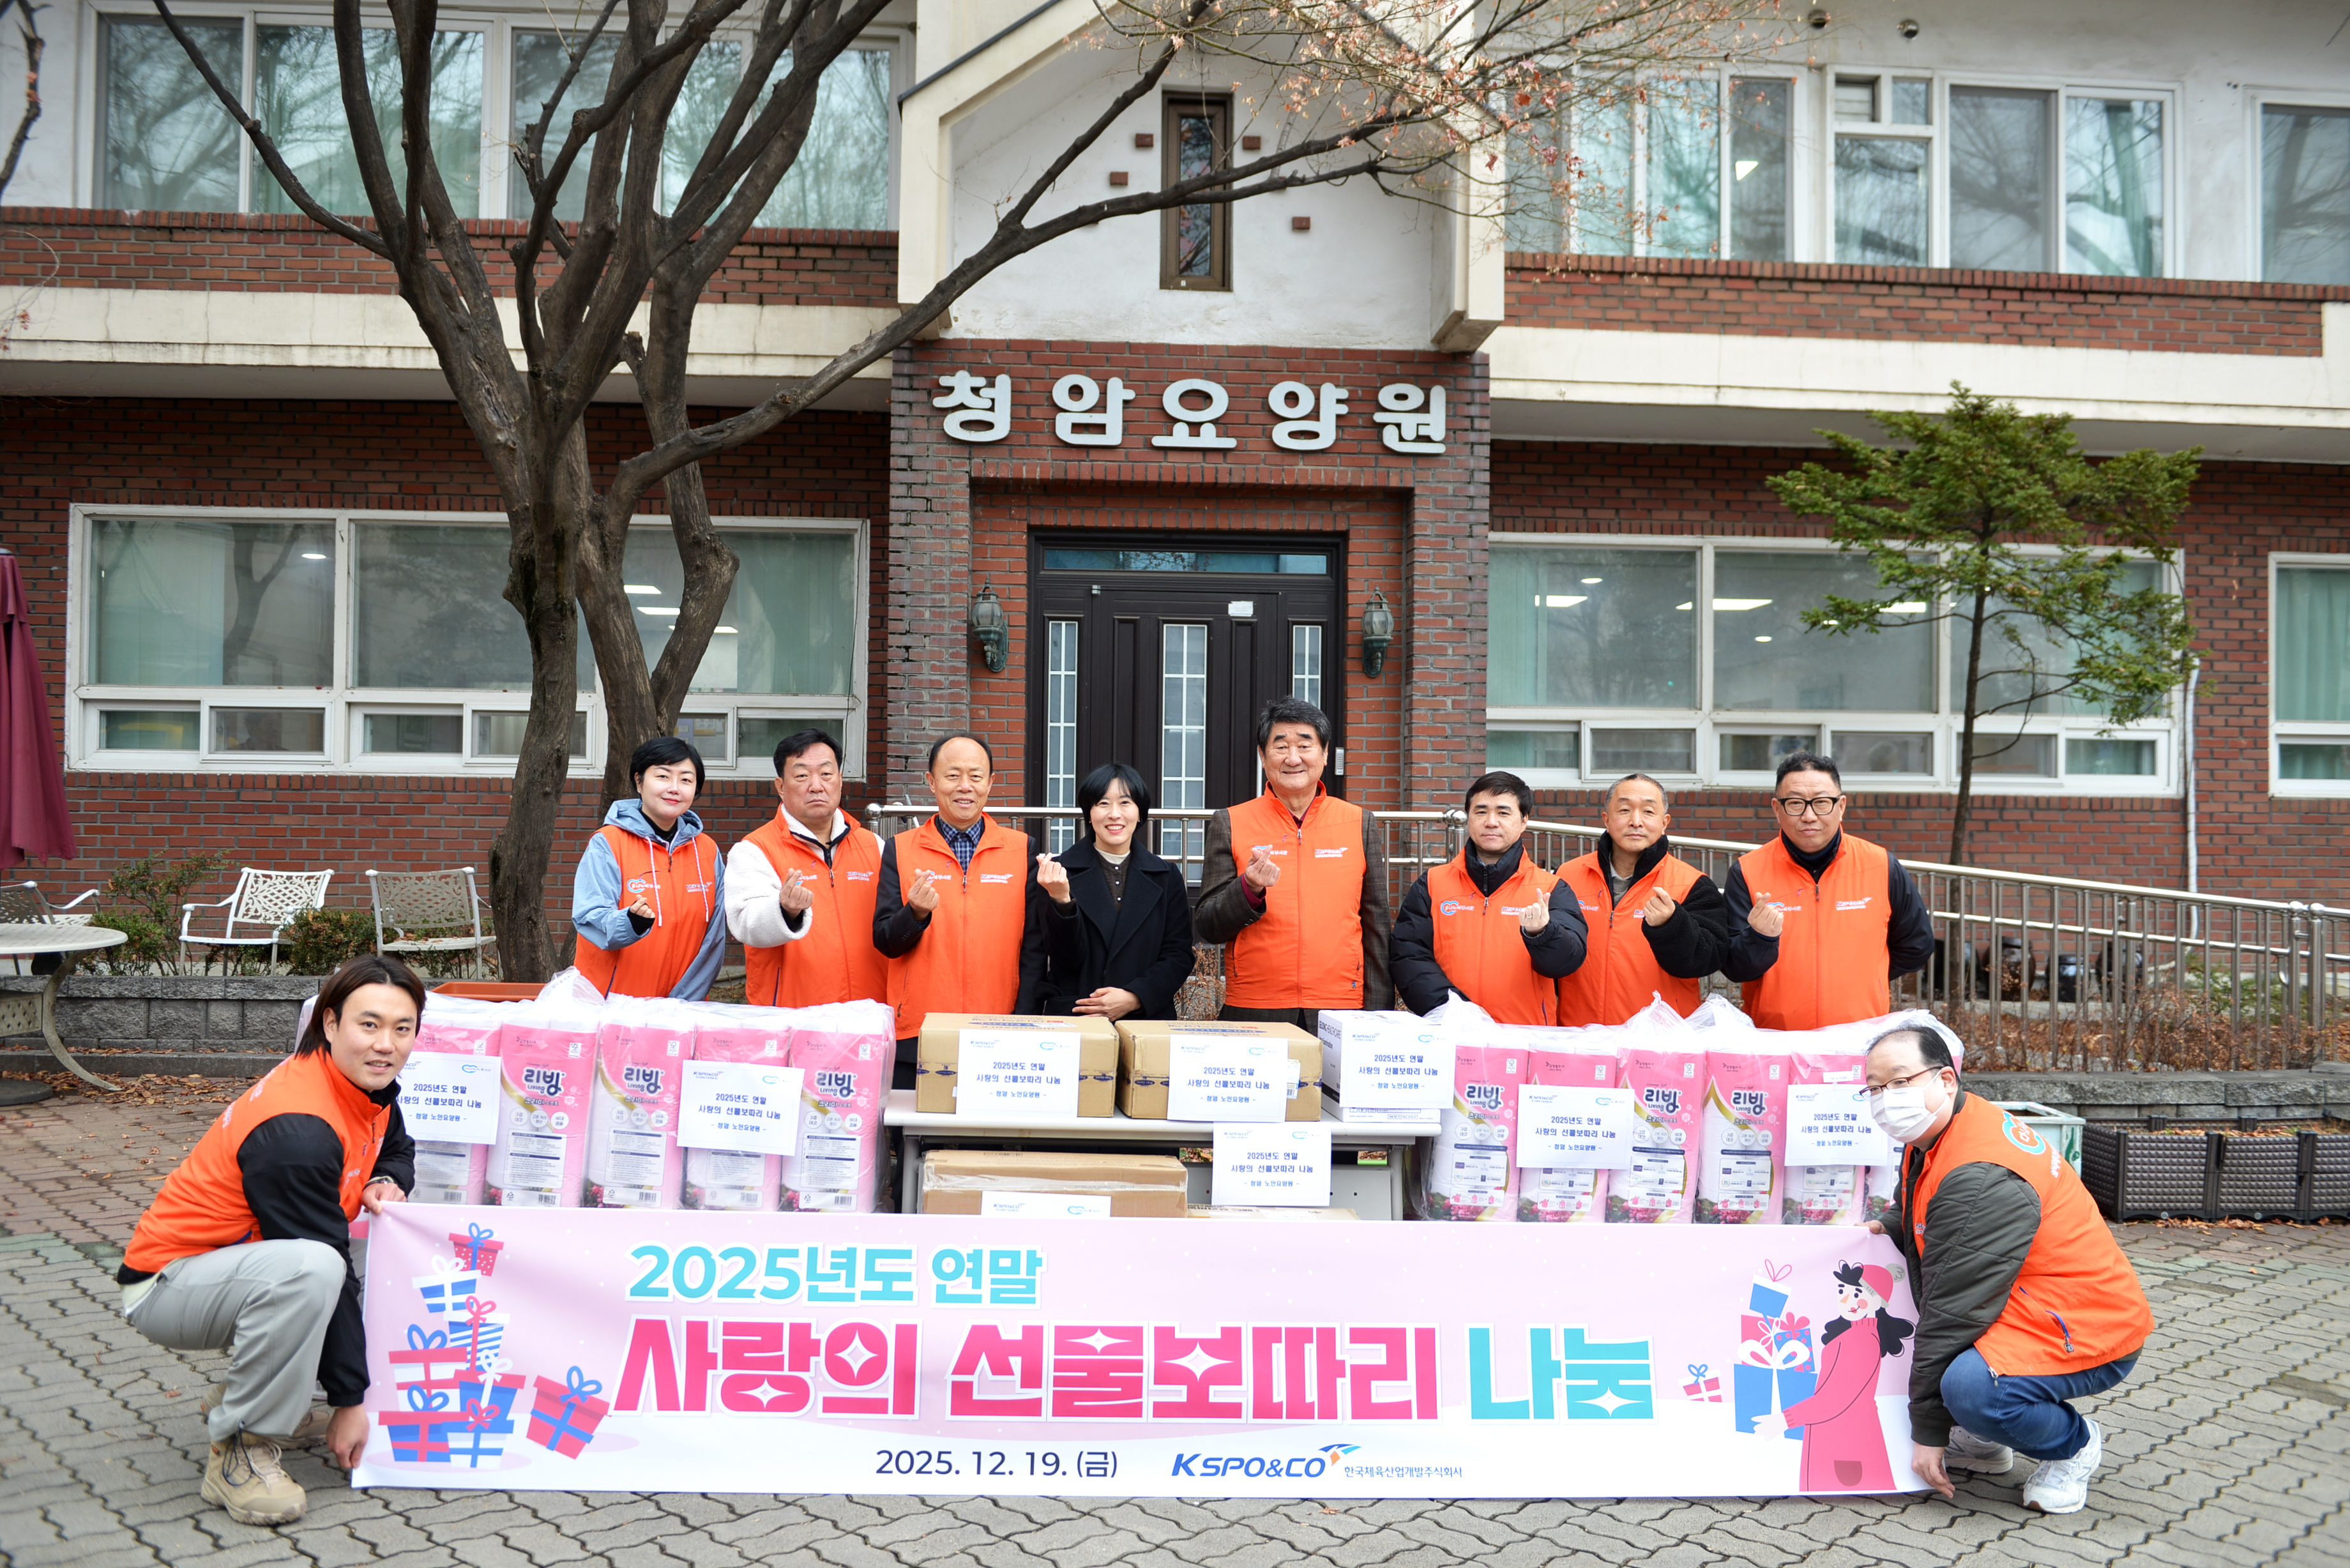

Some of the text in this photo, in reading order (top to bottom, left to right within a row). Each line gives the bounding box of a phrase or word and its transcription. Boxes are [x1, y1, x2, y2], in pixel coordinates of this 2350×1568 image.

[932, 370, 1446, 455] 청암요양원
[994, 1062, 1026, 1070] 2025년도
[1204, 1067, 1235, 1075] 2025년도
[414, 1083, 466, 1094] 2025년도 연말
[524, 1069, 562, 1096] 리빙
[625, 1067, 661, 1094] 리빙
[817, 1073, 854, 1097] 리빙
[396, 1095, 419, 1106] 사랑의
[467, 1100, 481, 1108] 나눔
[716, 1094, 766, 1104] 2025년도 연말
[1467, 1085, 1501, 1110] 리빙
[1645, 1089, 1679, 1113] 리빙
[1732, 1092, 1765, 1115] 리빙
[699, 1105, 721, 1113] 사랑의
[767, 1111, 780, 1119] 나눔
[630, 1244, 1043, 1304] 2025년도 연말
[613, 1318, 1655, 1421] 사랑의 선물보따리 나눔
[876, 1450, 1118, 1479] 2025. 12. 19. (금)
[1171, 1453, 1327, 1478] KSPO&CO
[1344, 1465, 1463, 1479] 한국체육산업개발주식회사
